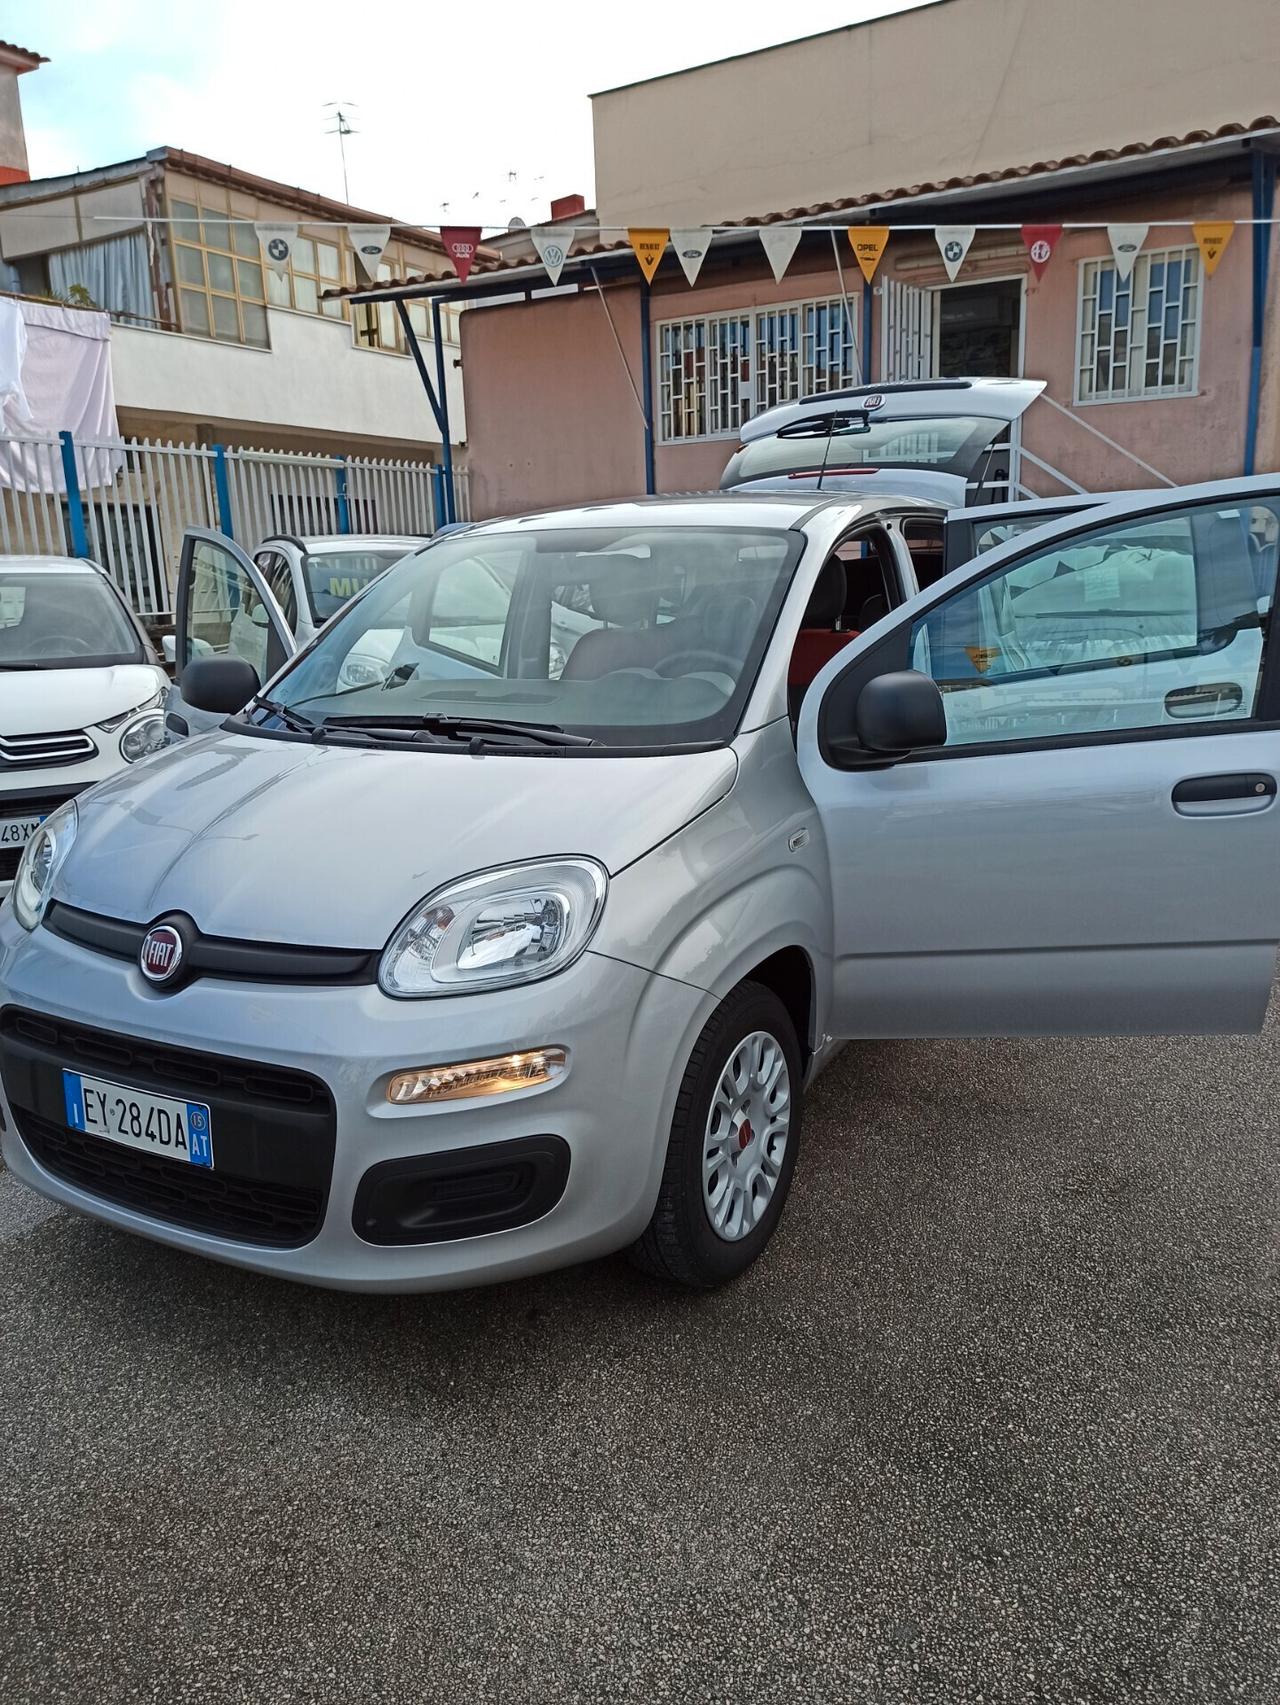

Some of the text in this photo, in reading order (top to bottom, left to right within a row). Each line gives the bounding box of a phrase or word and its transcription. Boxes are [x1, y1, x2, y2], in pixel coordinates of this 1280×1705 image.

[148, 941, 174, 967] FIAT
[115, 1098, 188, 1151] 284DA
[192, 1133, 208, 1157] AT
